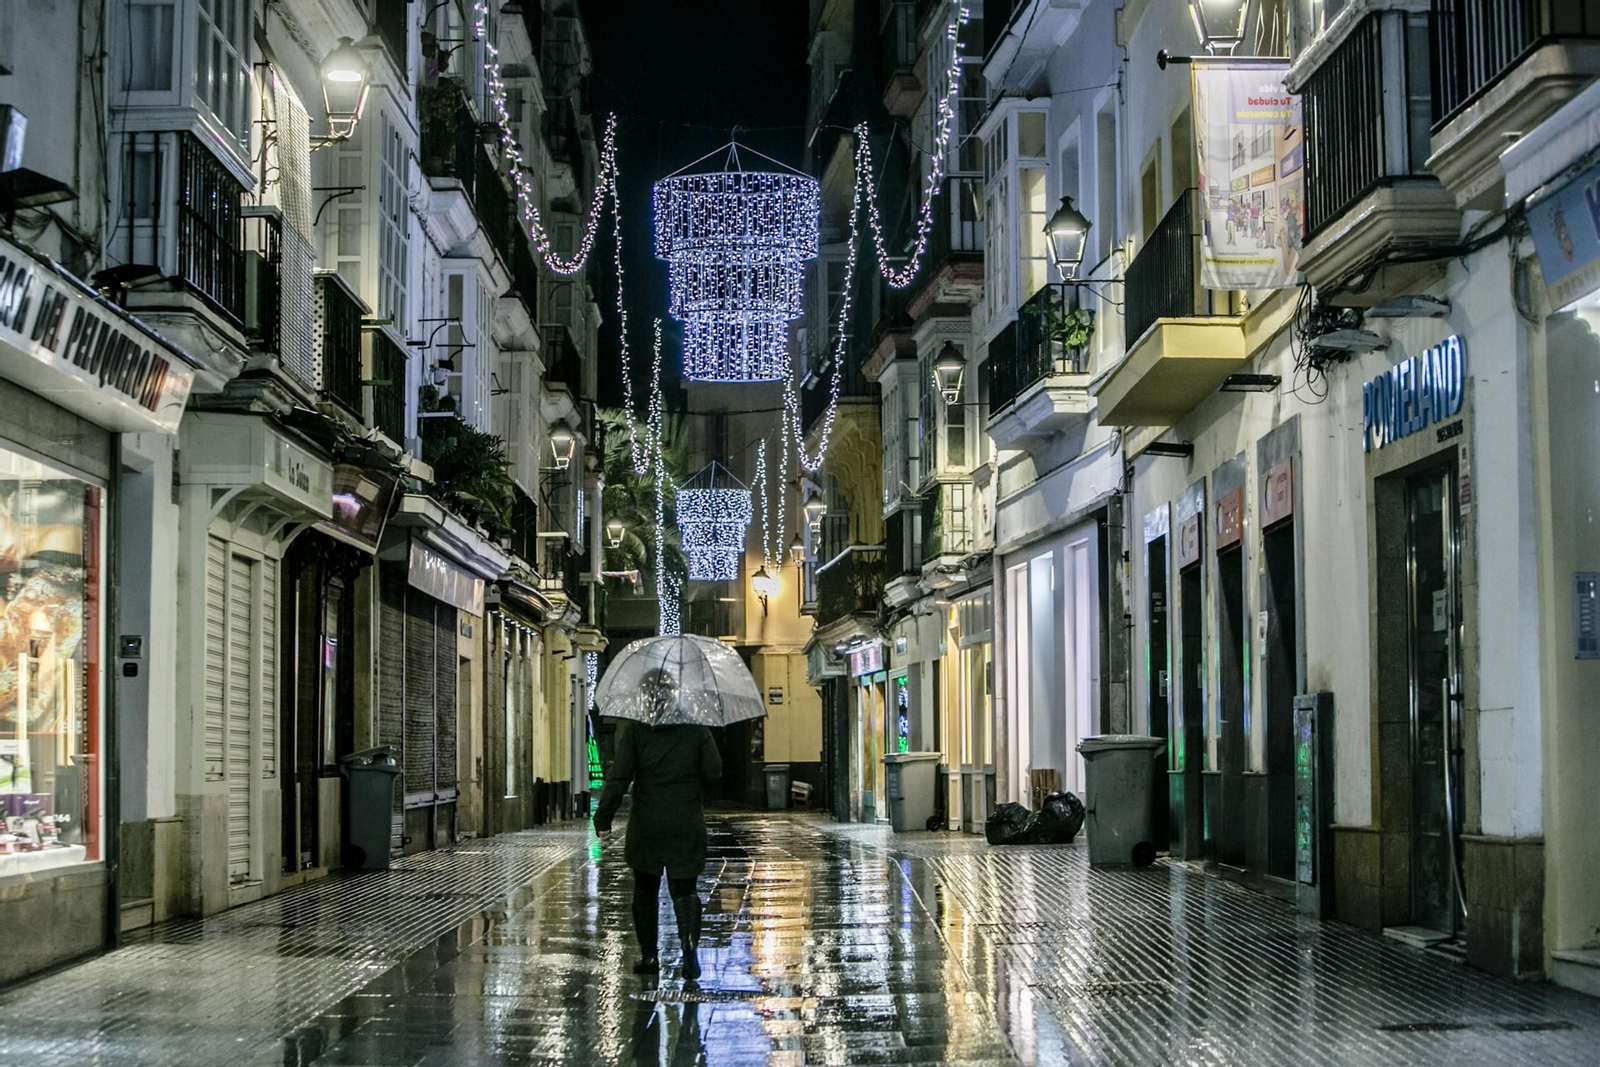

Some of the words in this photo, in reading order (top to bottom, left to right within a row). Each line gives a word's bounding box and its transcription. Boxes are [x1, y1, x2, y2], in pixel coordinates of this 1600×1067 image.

[0, 255, 34, 334] ASA
[31, 285, 69, 353] DEL
[63, 306, 150, 400] PELUQUERO
